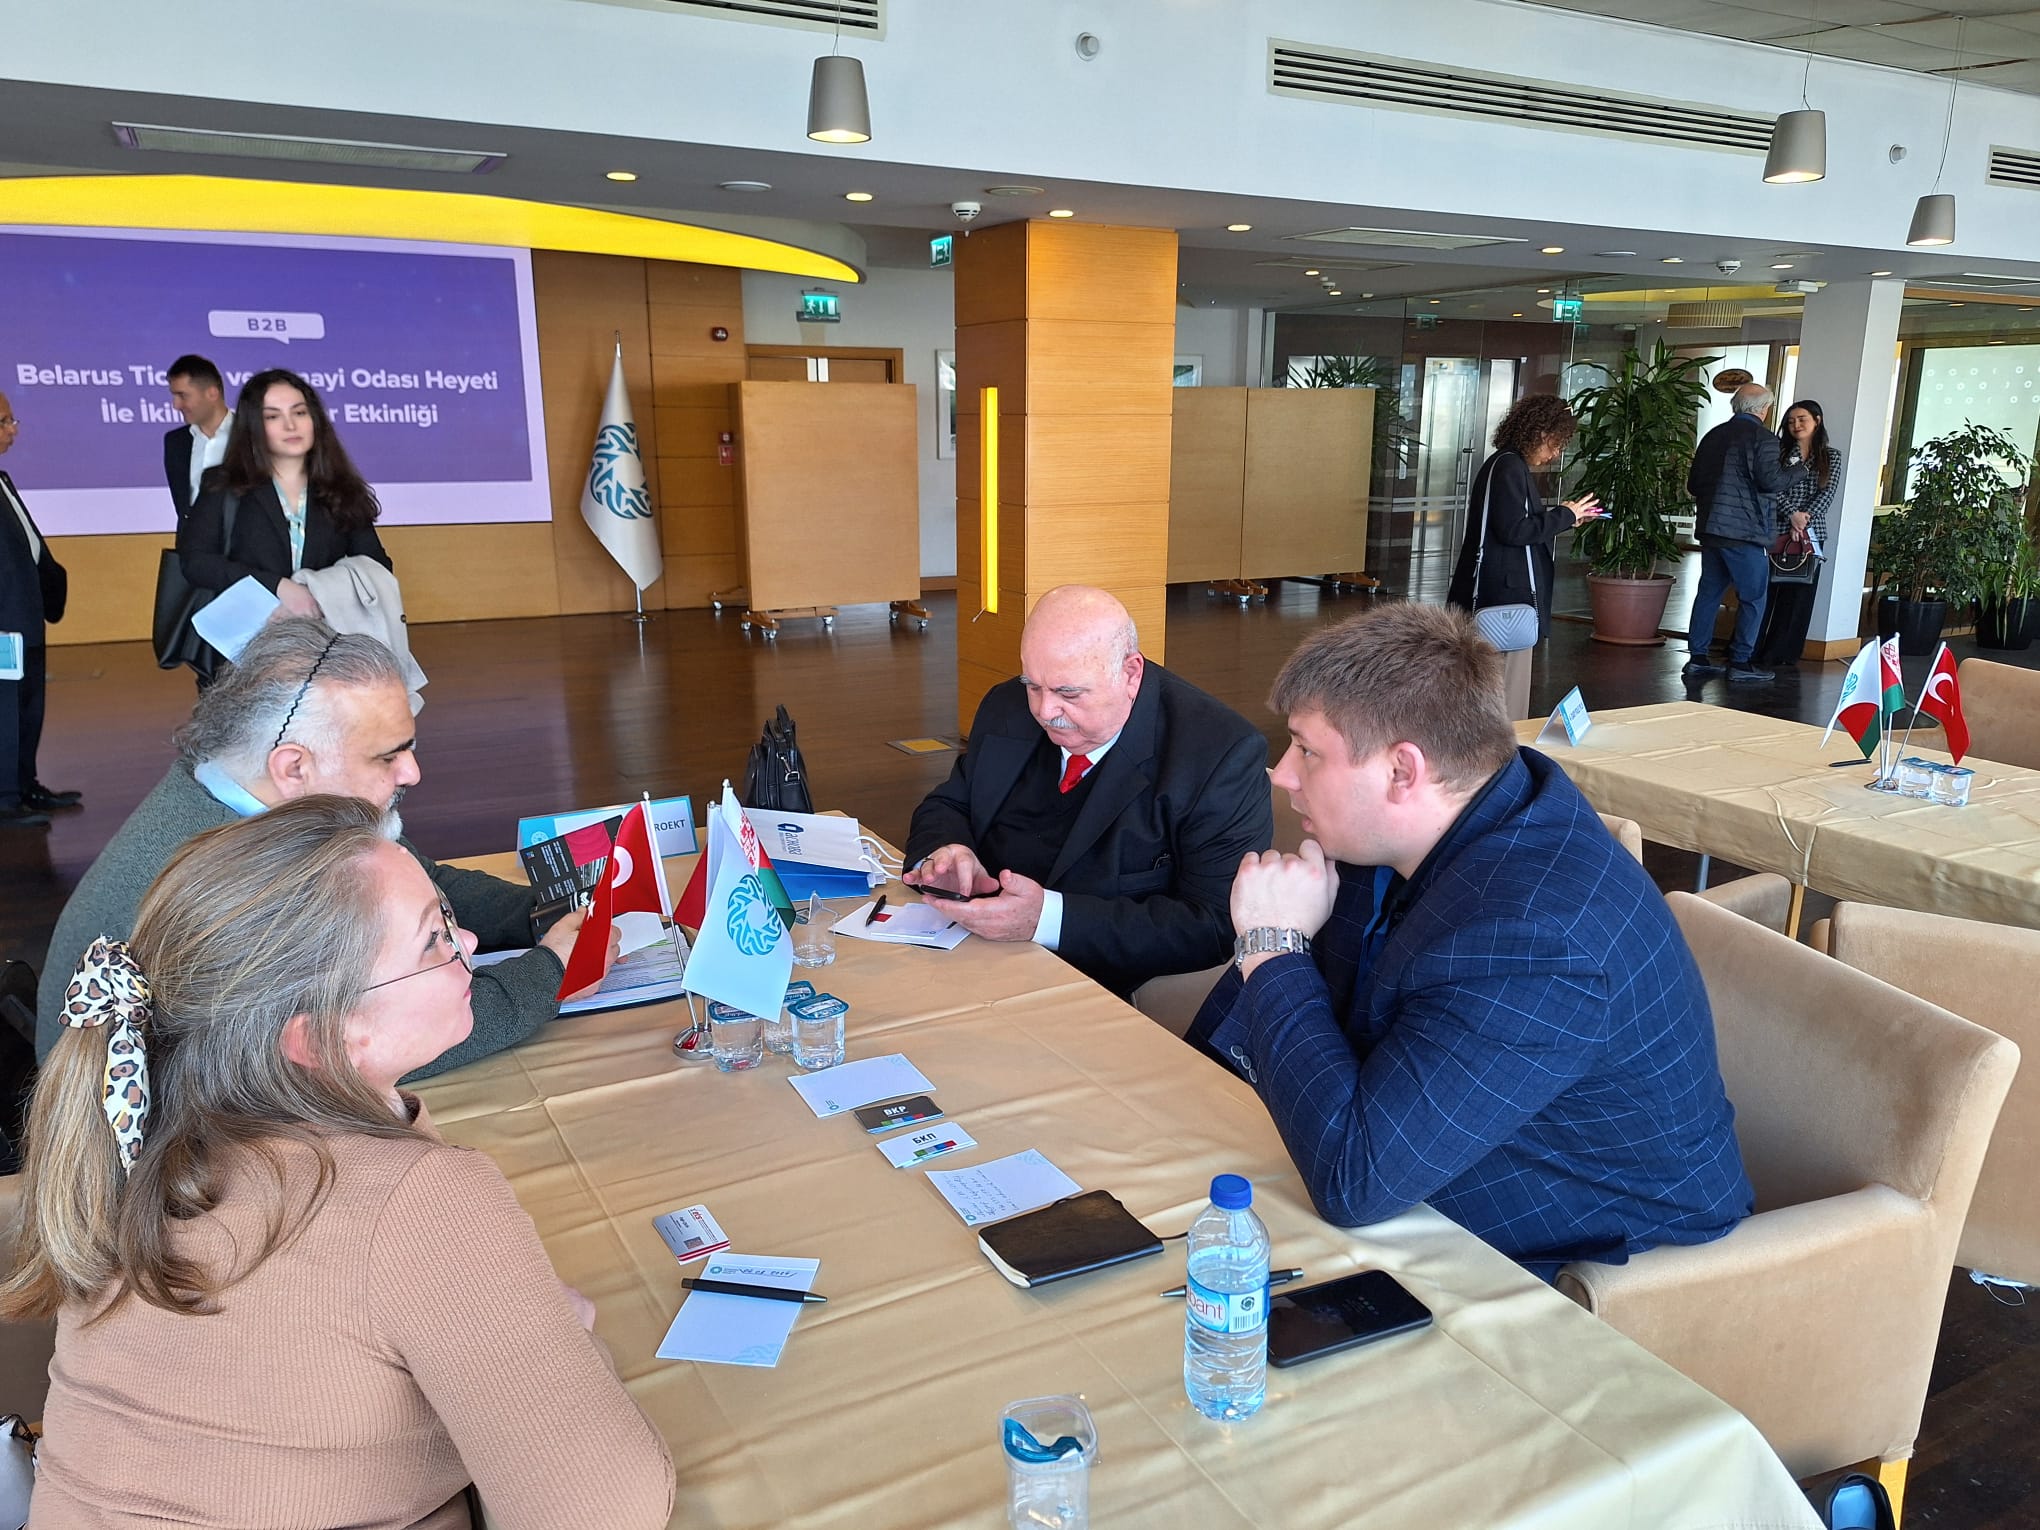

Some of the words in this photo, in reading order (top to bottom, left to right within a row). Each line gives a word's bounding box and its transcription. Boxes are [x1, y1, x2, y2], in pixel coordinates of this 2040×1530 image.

[247, 318, 288, 332] B2B
[16, 363, 124, 386] Belarus
[225, 371, 254, 387] ve
[296, 367, 346, 392] nayi
[351, 368, 420, 389] Odası
[424, 370, 499, 394] Heyeti
[101, 398, 134, 424] İle
[343, 403, 440, 429] Etkinliği
[653, 819, 686, 832] ROEKT
[1187, 1286, 1224, 1321] bant
